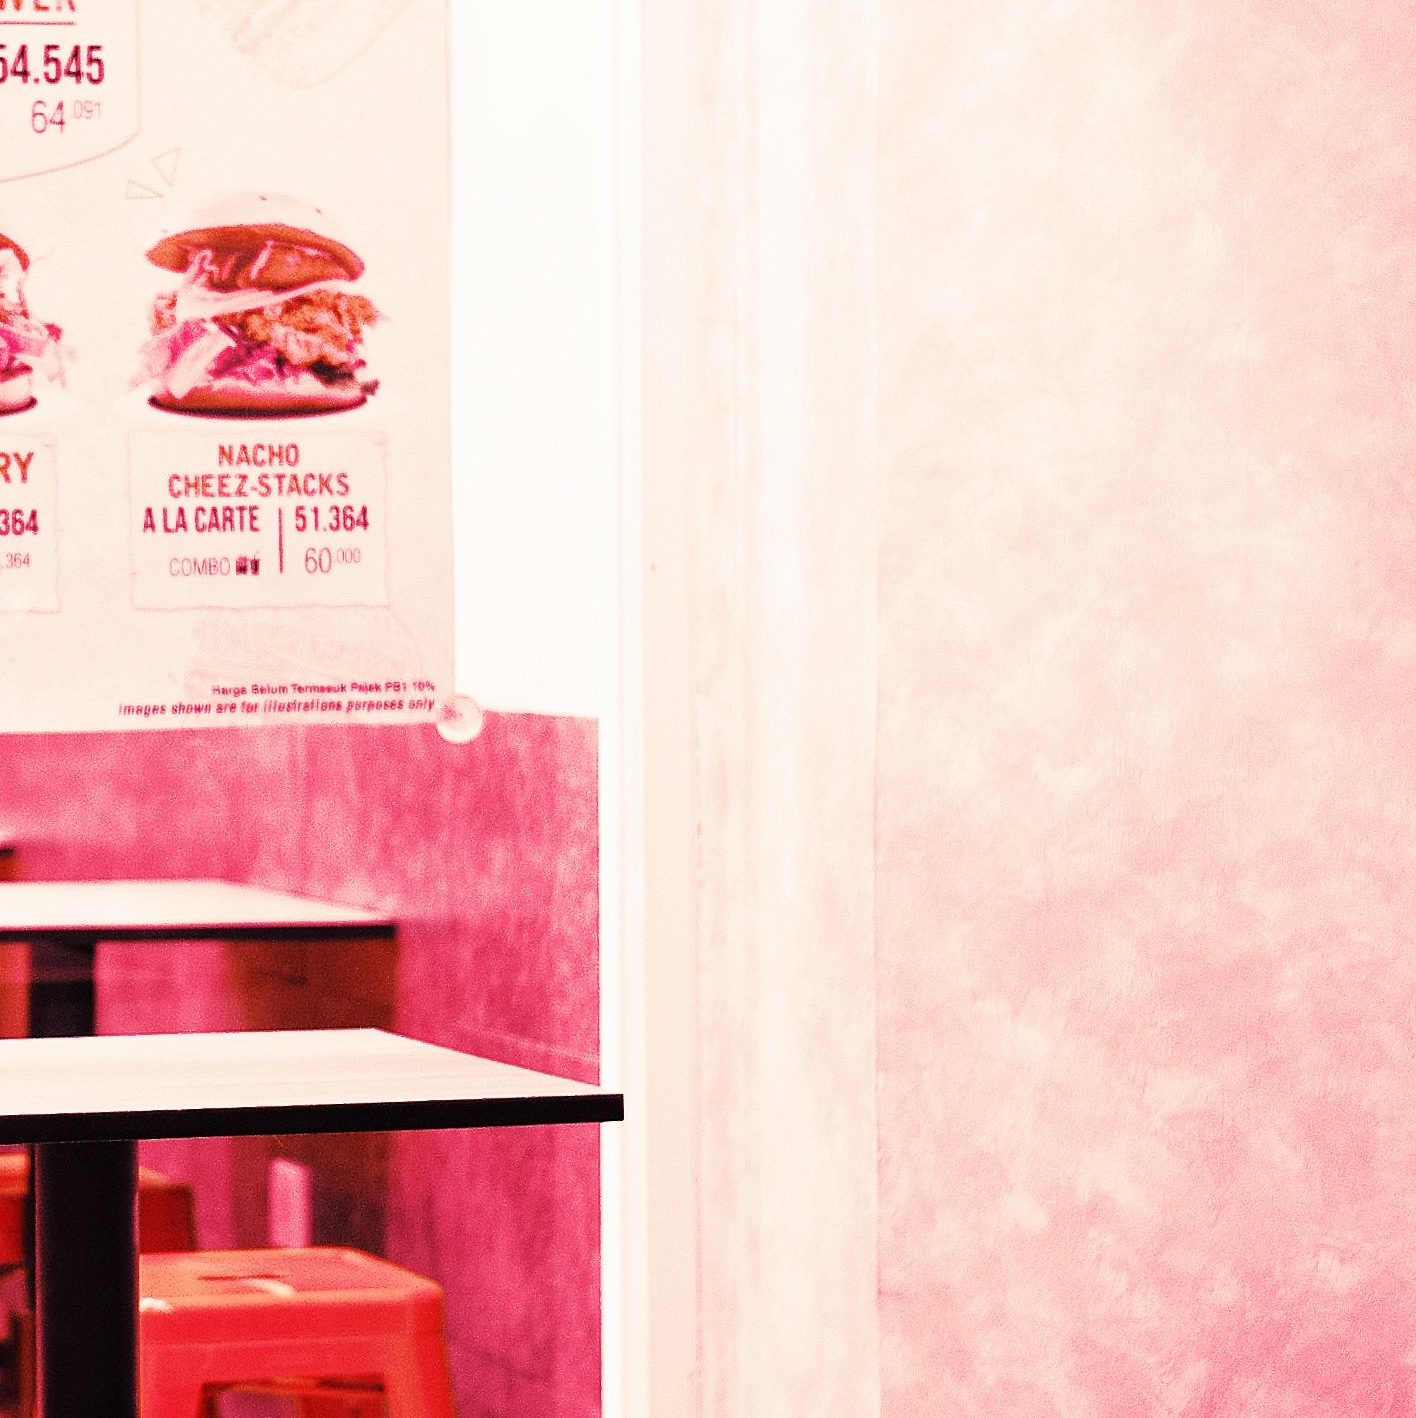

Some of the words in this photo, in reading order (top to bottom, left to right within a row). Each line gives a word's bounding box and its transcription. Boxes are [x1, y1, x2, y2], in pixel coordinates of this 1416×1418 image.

[218, 442, 300, 468] NACHO
[168, 472, 351, 499] CHEEZ-STACKS
[142, 506, 156, 533] A
[162, 506, 188, 534] LA
[194, 504, 260, 534] CARTE
[294, 504, 370, 533] 51.364
[169, 556, 231, 577] COMBO
[211, 685, 248, 698] Harga
[251, 683, 289, 695] Belum
[171, 702, 212, 715] shown
[215, 702, 237, 714] are
[407, 697, 435, 712] only
